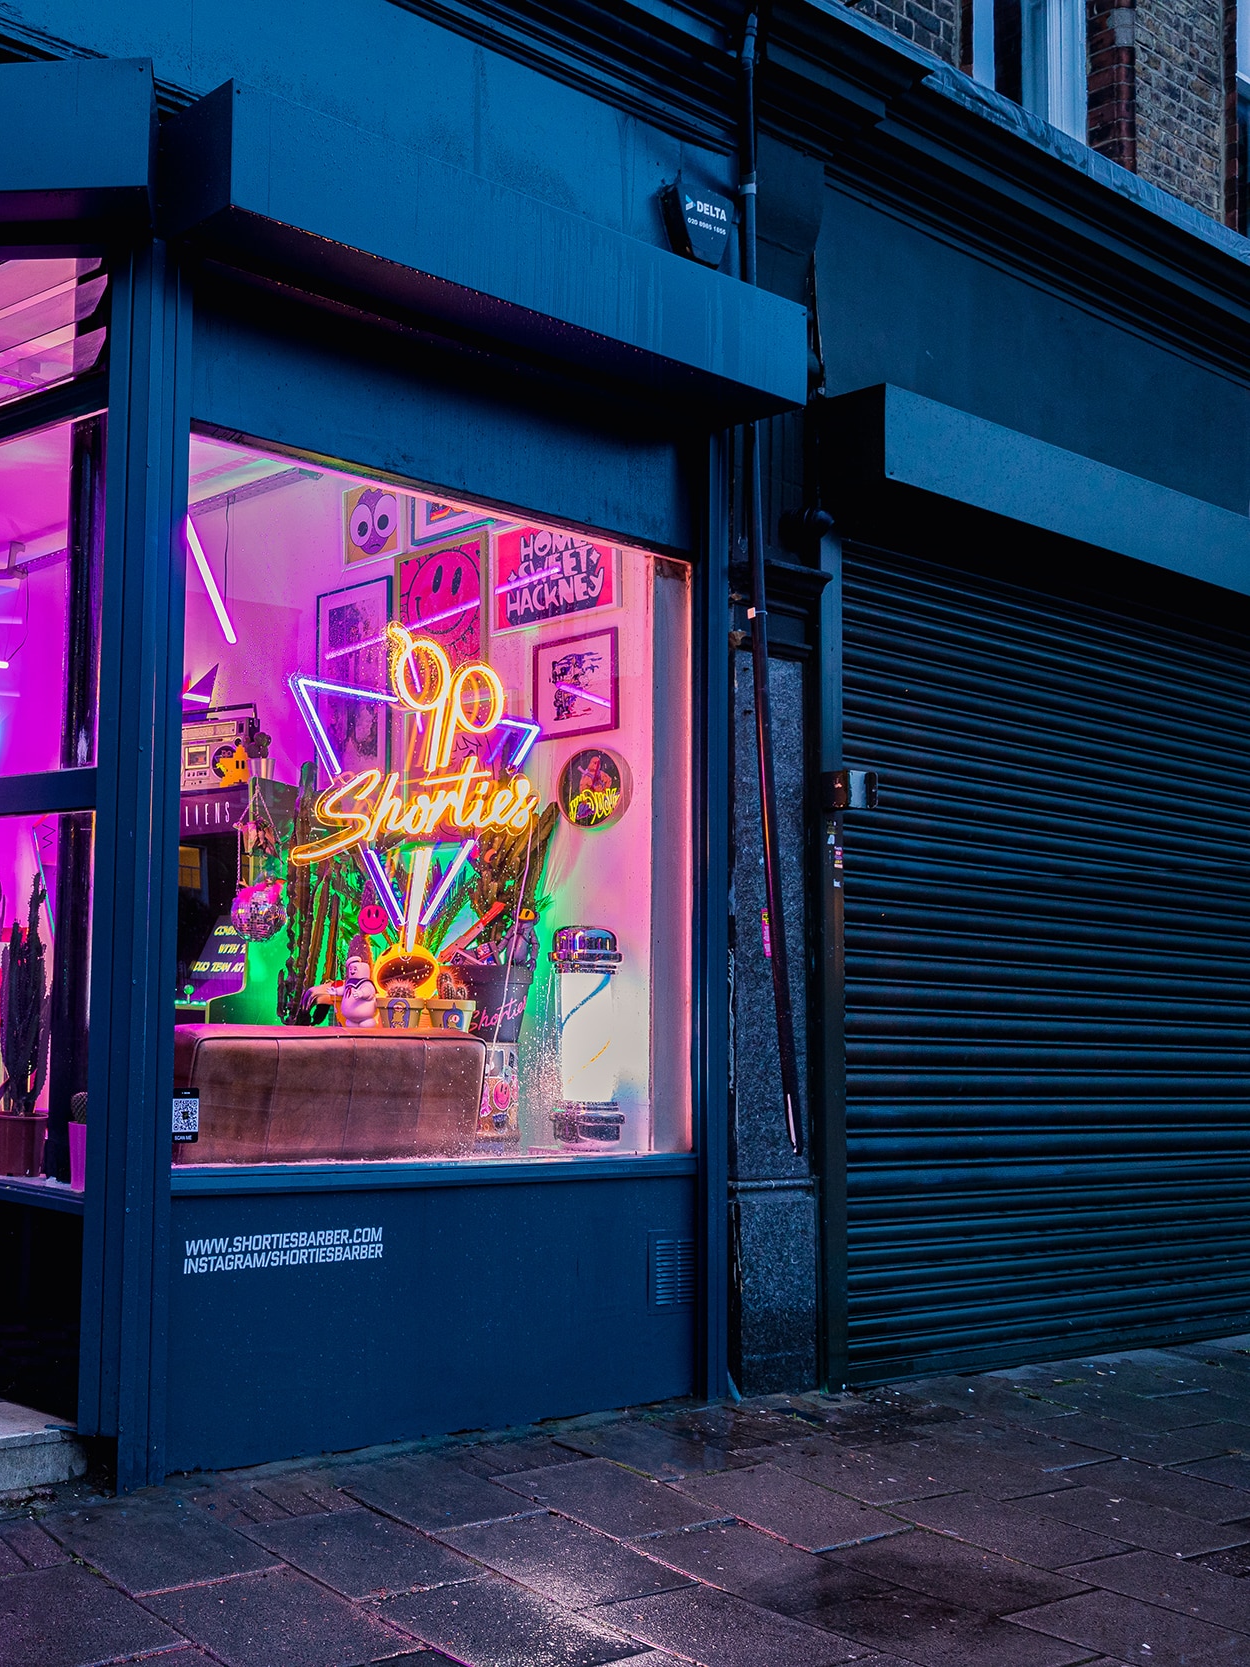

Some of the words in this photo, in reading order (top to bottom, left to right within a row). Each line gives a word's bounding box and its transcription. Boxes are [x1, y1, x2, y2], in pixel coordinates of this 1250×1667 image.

[696, 200, 727, 222] DELTA
[518, 544, 593, 589] SWEET
[507, 566, 604, 619] HACKNEY
[293, 756, 539, 862] Shorties
[183, 1243, 384, 1275] INSTAGRAM/SHORTIESBARBER
[185, 1226, 383, 1257] WWW.SHORTIESBARBER.COM
